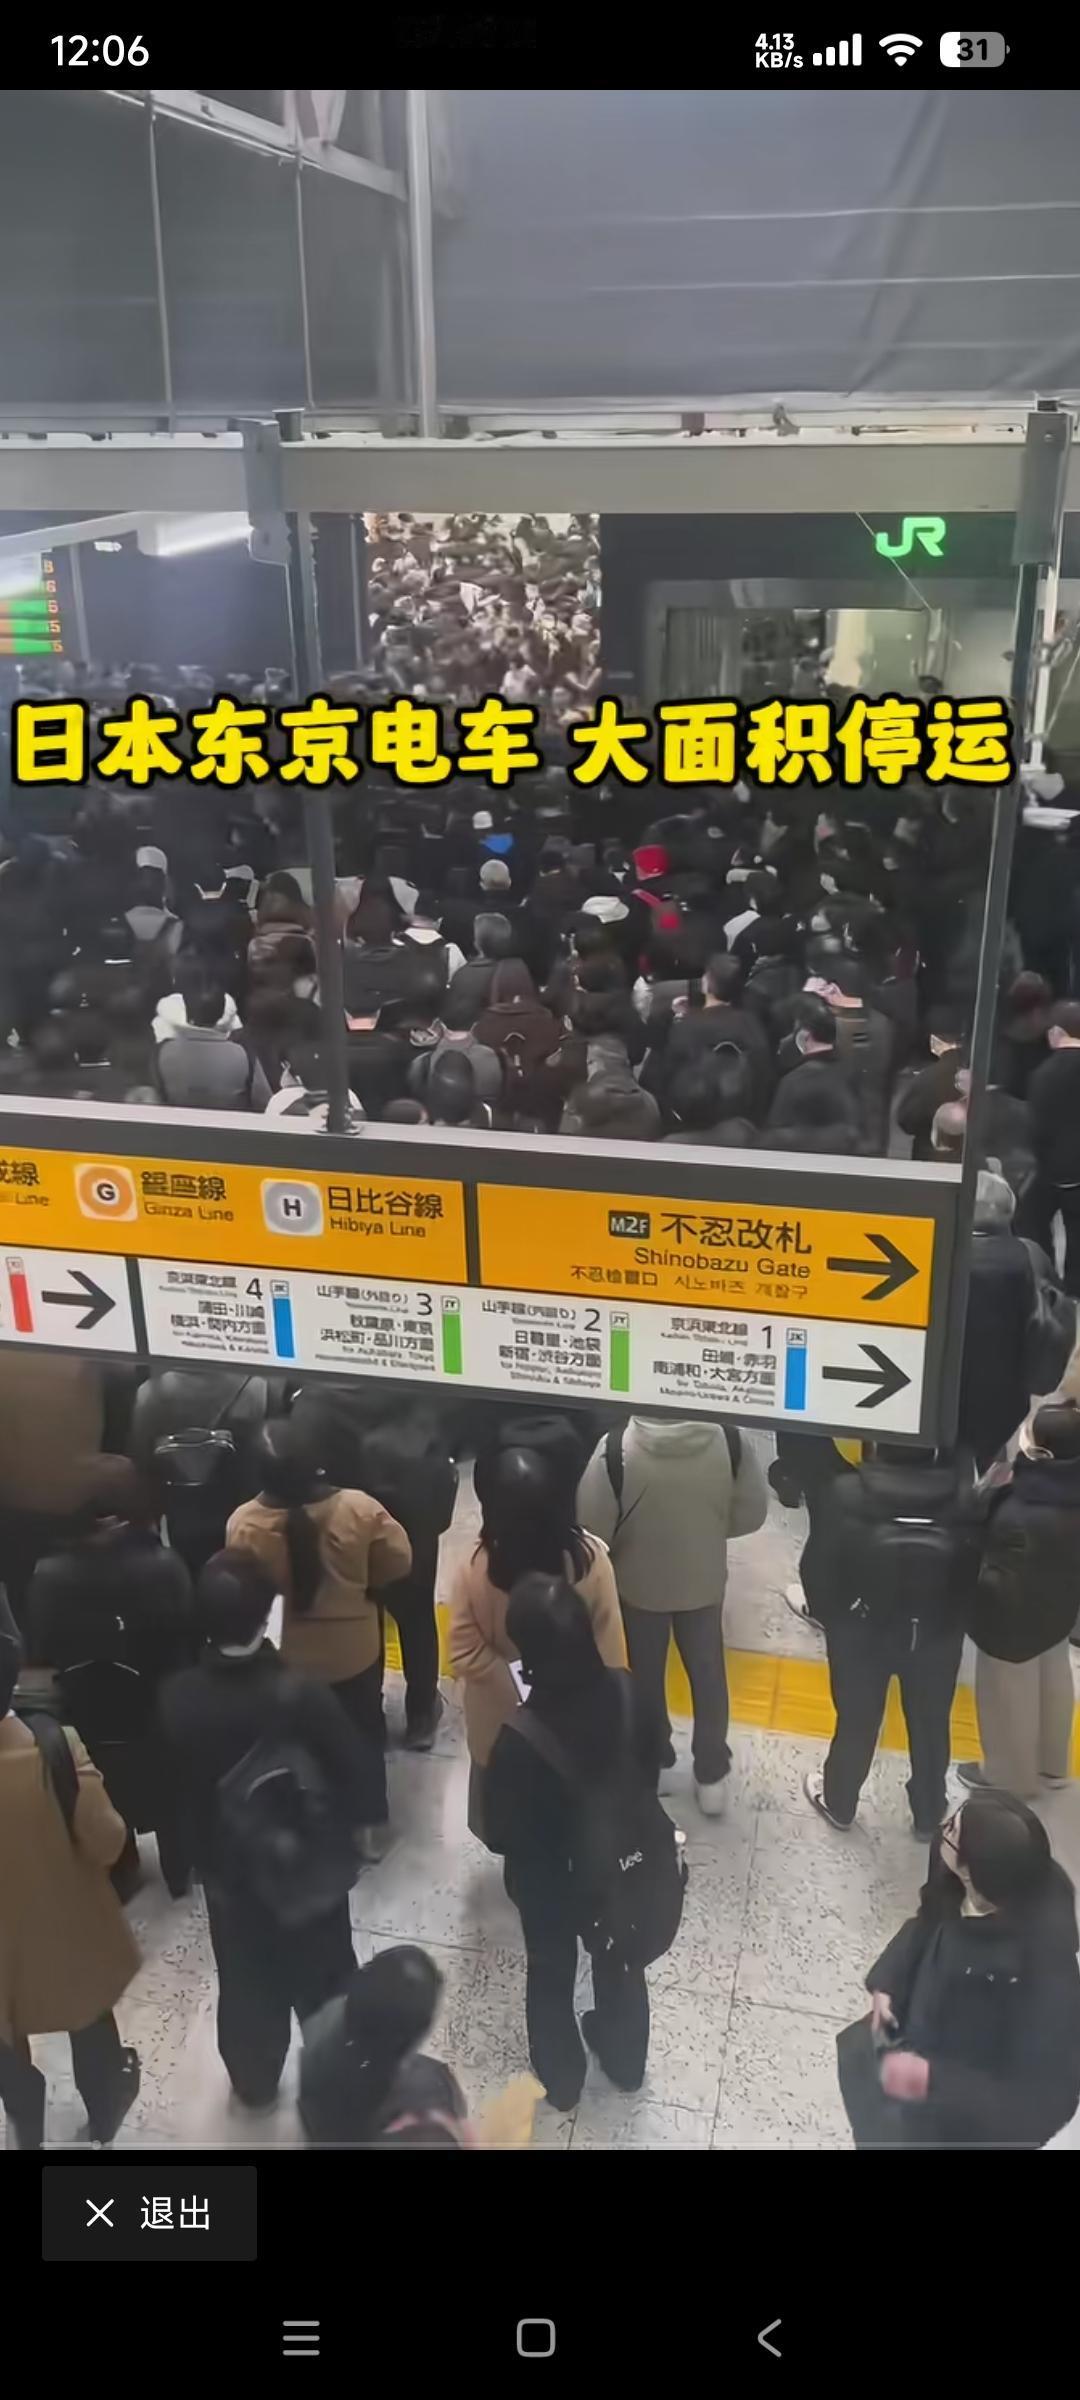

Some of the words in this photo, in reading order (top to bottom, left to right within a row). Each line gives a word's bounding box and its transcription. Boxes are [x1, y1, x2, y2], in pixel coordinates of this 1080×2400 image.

[876, 517, 946, 557] JR
[97, 1183, 116, 1201] G
[328, 1186, 444, 1219] 日比谷線
[144, 1202, 193, 1218] Ginza
[198, 1206, 234, 1221] Line
[283, 1197, 302, 1217] H
[330, 1217, 384, 1236] Hibiya
[390, 1222, 426, 1238] Line
[610, 1215, 649, 1235] M2F
[660, 1212, 812, 1254] 不忍改札
[634, 1247, 749, 1272] Shinobazu
[757, 1258, 811, 1279] Gate
[246, 1278, 263, 1300] 4
[416, 1292, 433, 1315] 3
[584, 1308, 602, 1332] 2
[761, 1325, 772, 1349] 1
